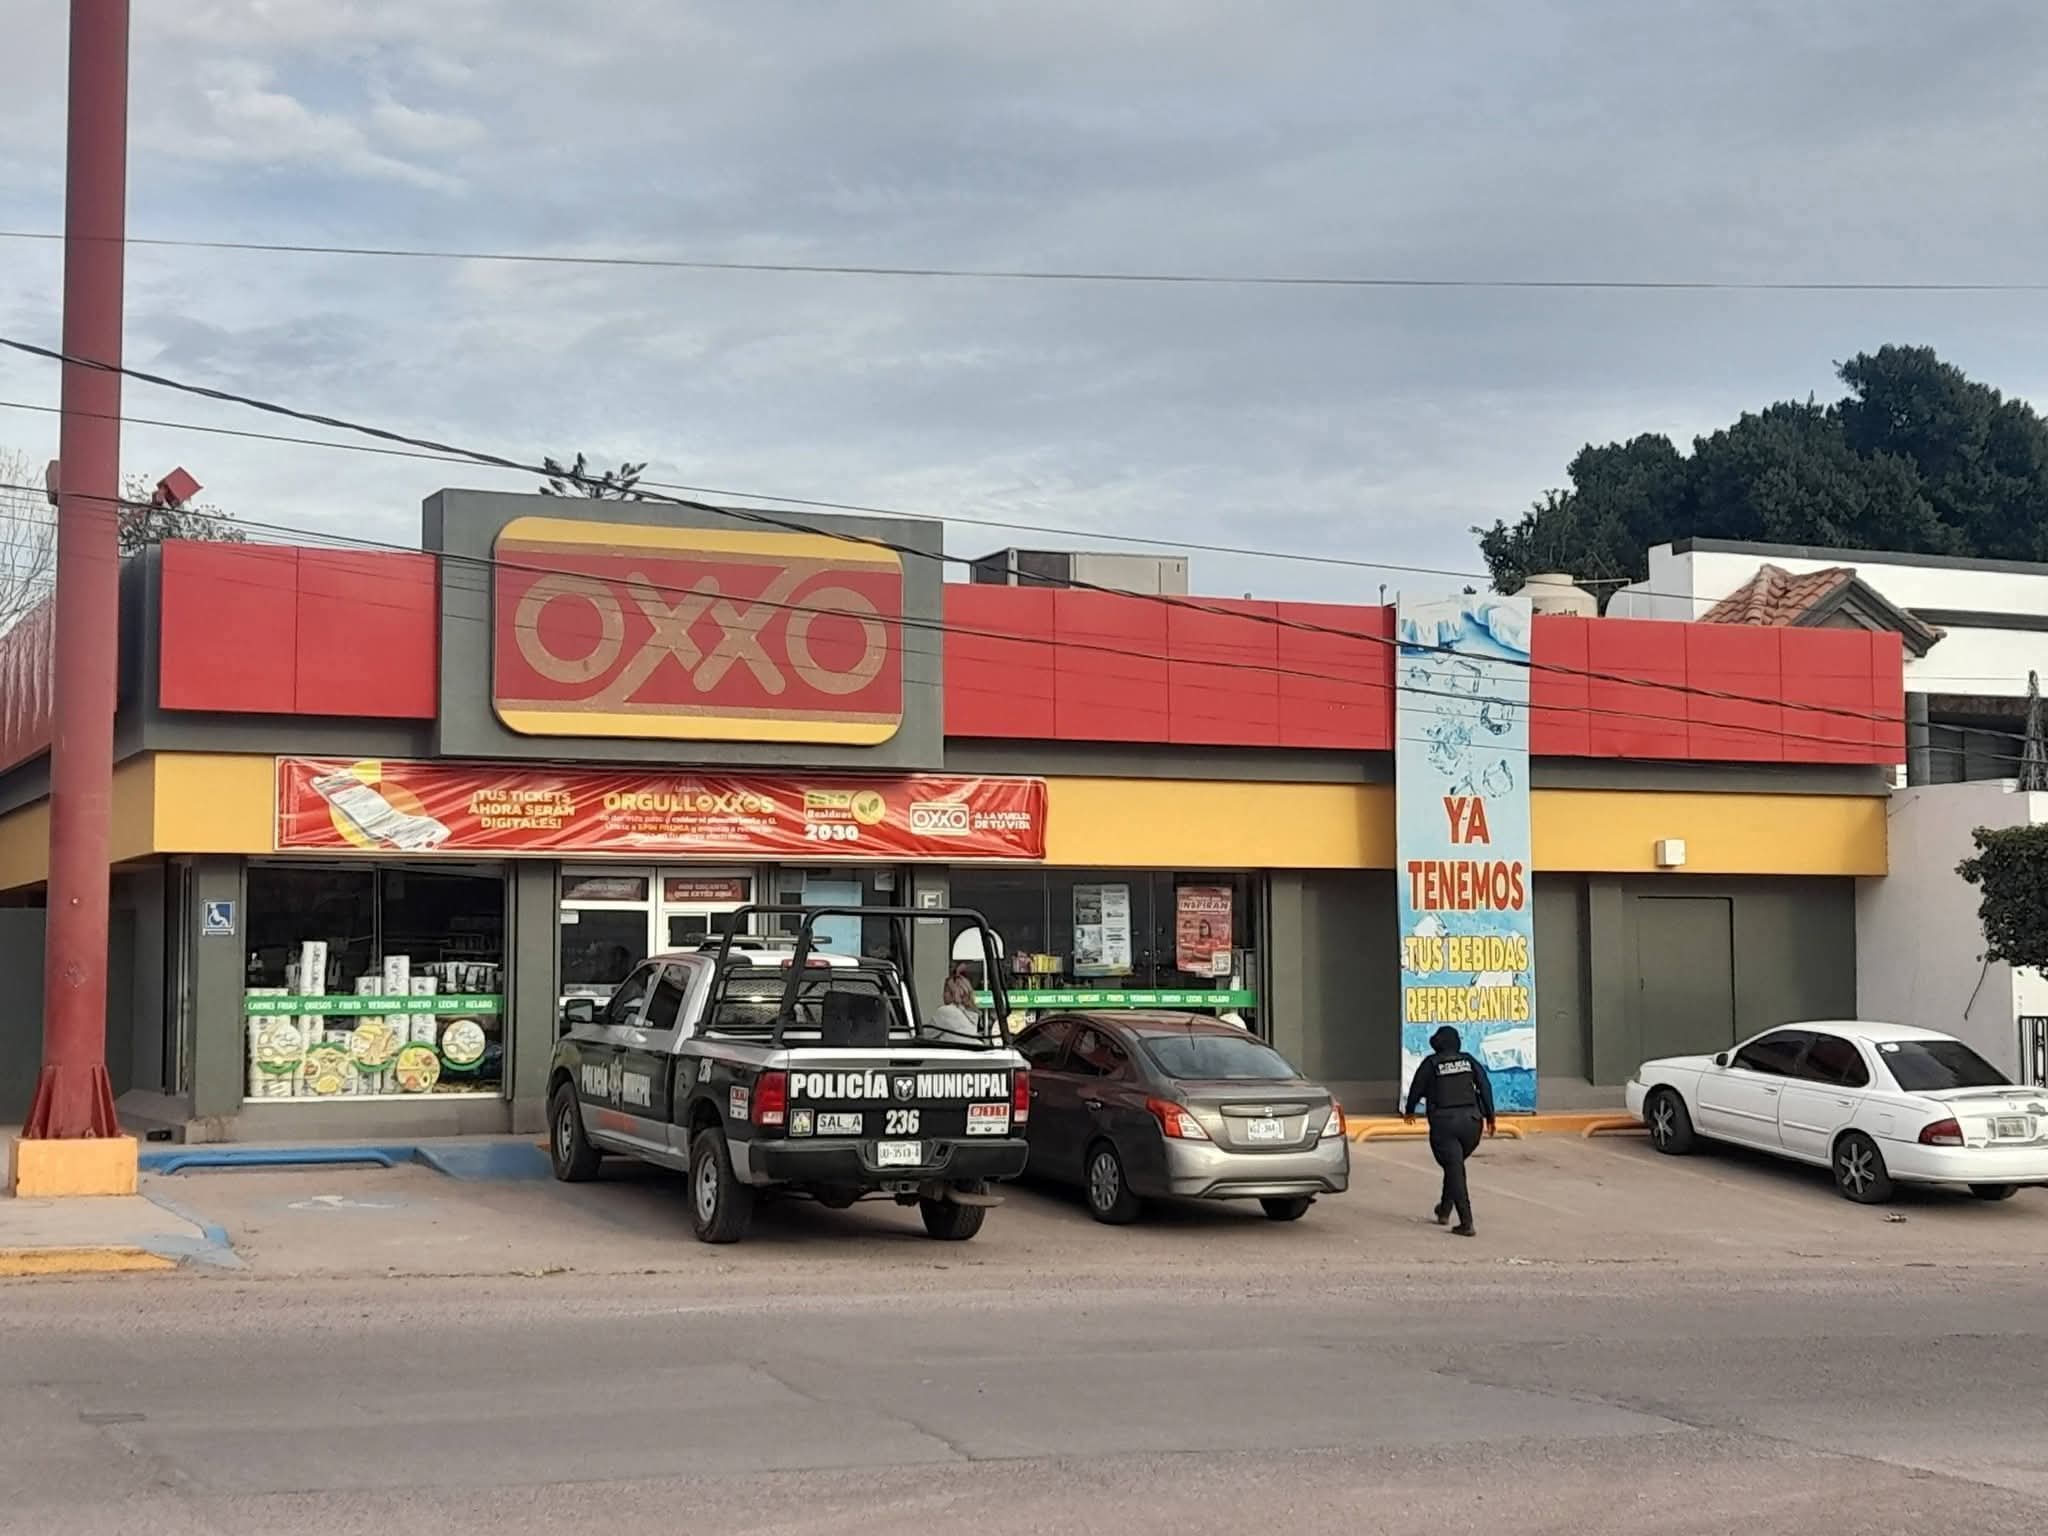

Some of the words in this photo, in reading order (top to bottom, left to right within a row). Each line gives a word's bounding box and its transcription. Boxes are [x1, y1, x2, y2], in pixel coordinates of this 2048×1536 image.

[514, 568, 888, 700] OXXO
[468, 803, 522, 815] AHORA
[510, 790, 571, 805] TICKETS
[804, 824, 859, 840] 2030
[913, 810, 967, 828] OXXO
[975, 820, 988, 829] DE
[990, 820, 1005, 829] TU
[1443, 796, 1490, 844] YA
[1407, 860, 1524, 911] TENEMOS
[1404, 936, 1444, 972] TUS
[1448, 936, 1529, 972] BEBIDAS
[1406, 987, 1530, 1023] REFRESCANTES
[790, 1070, 889, 1099] POLICÍA
[917, 1073, 1009, 1098] MUNICIPAL
[885, 1109, 920, 1135] 236
